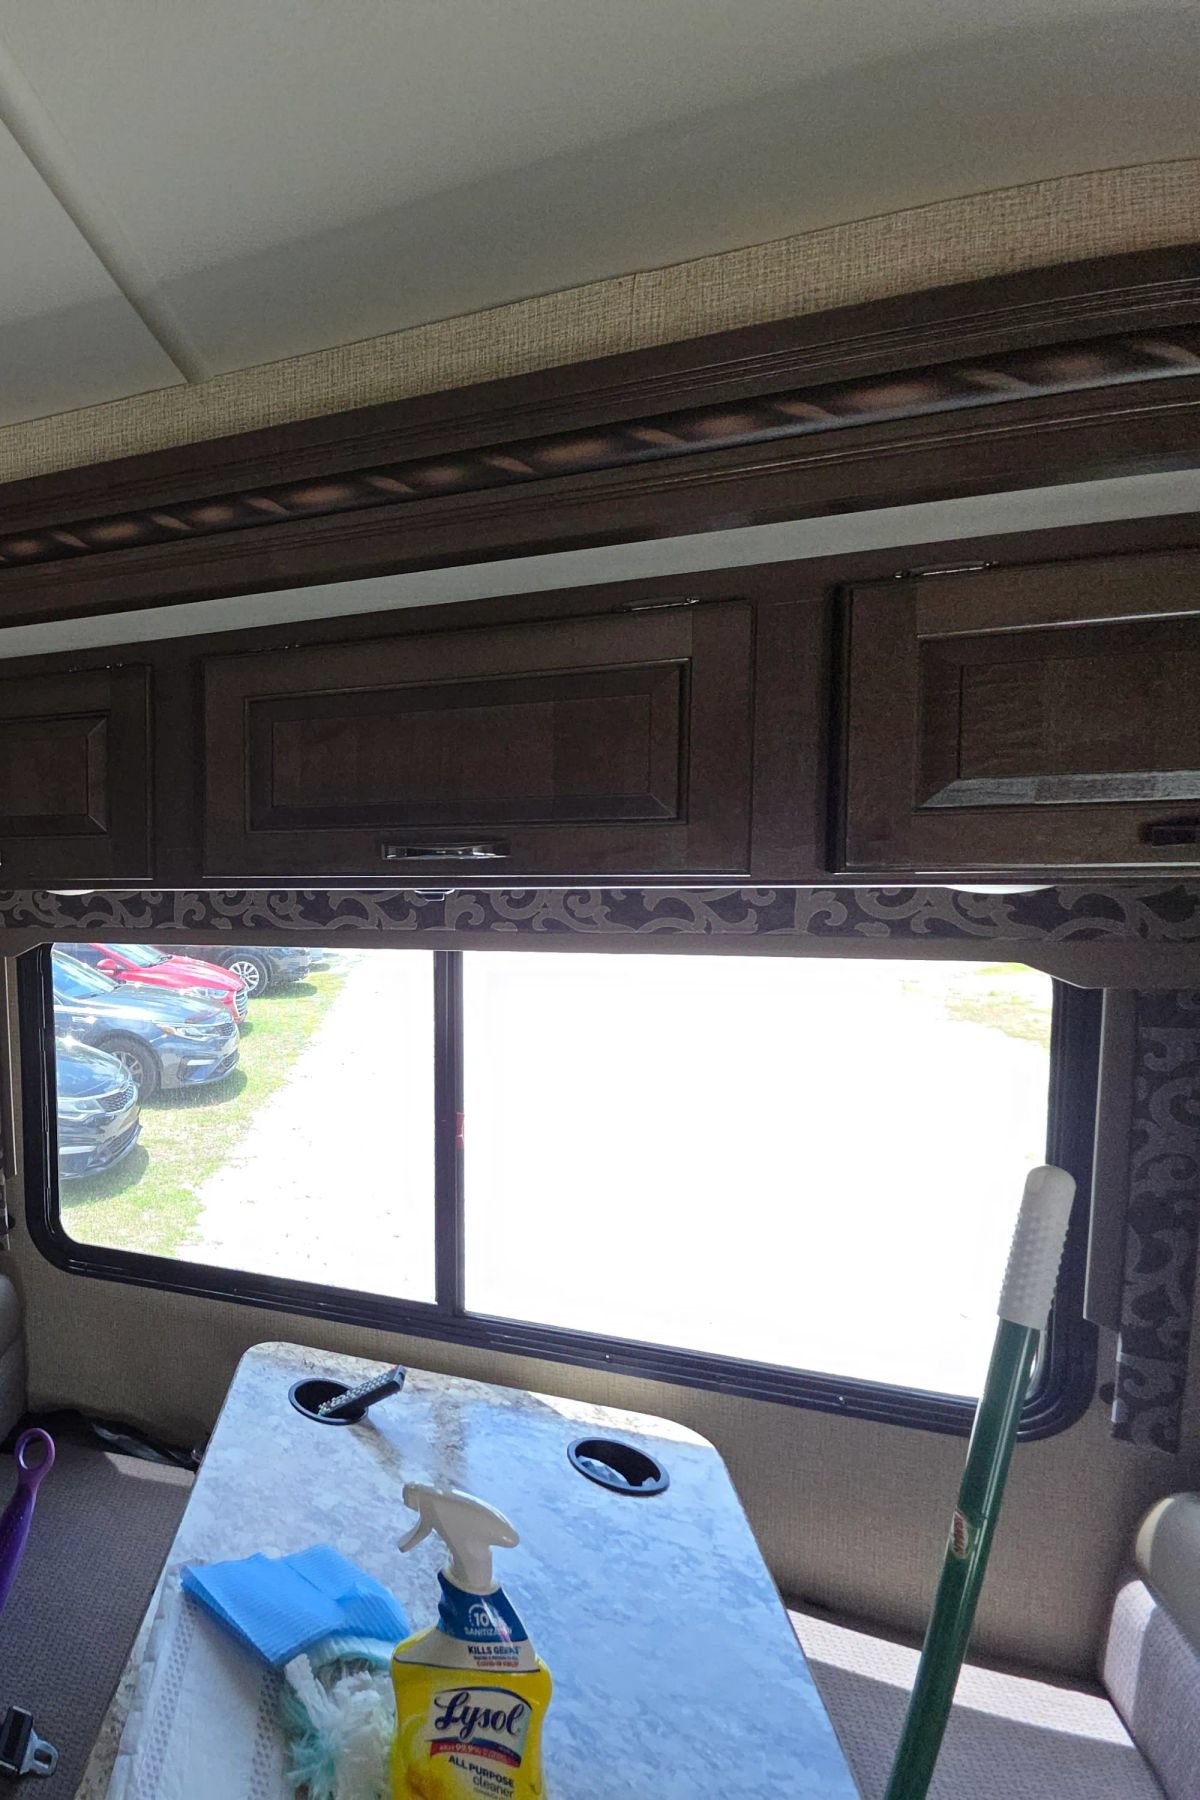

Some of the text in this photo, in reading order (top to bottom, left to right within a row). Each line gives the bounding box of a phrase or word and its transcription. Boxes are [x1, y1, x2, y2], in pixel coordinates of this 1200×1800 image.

[468, 1645, 492, 1655] KILLS
[433, 1692, 525, 1739] Lysol
[448, 1755, 468, 1770] ALL
[468, 1763, 514, 1788] PURPOSE
